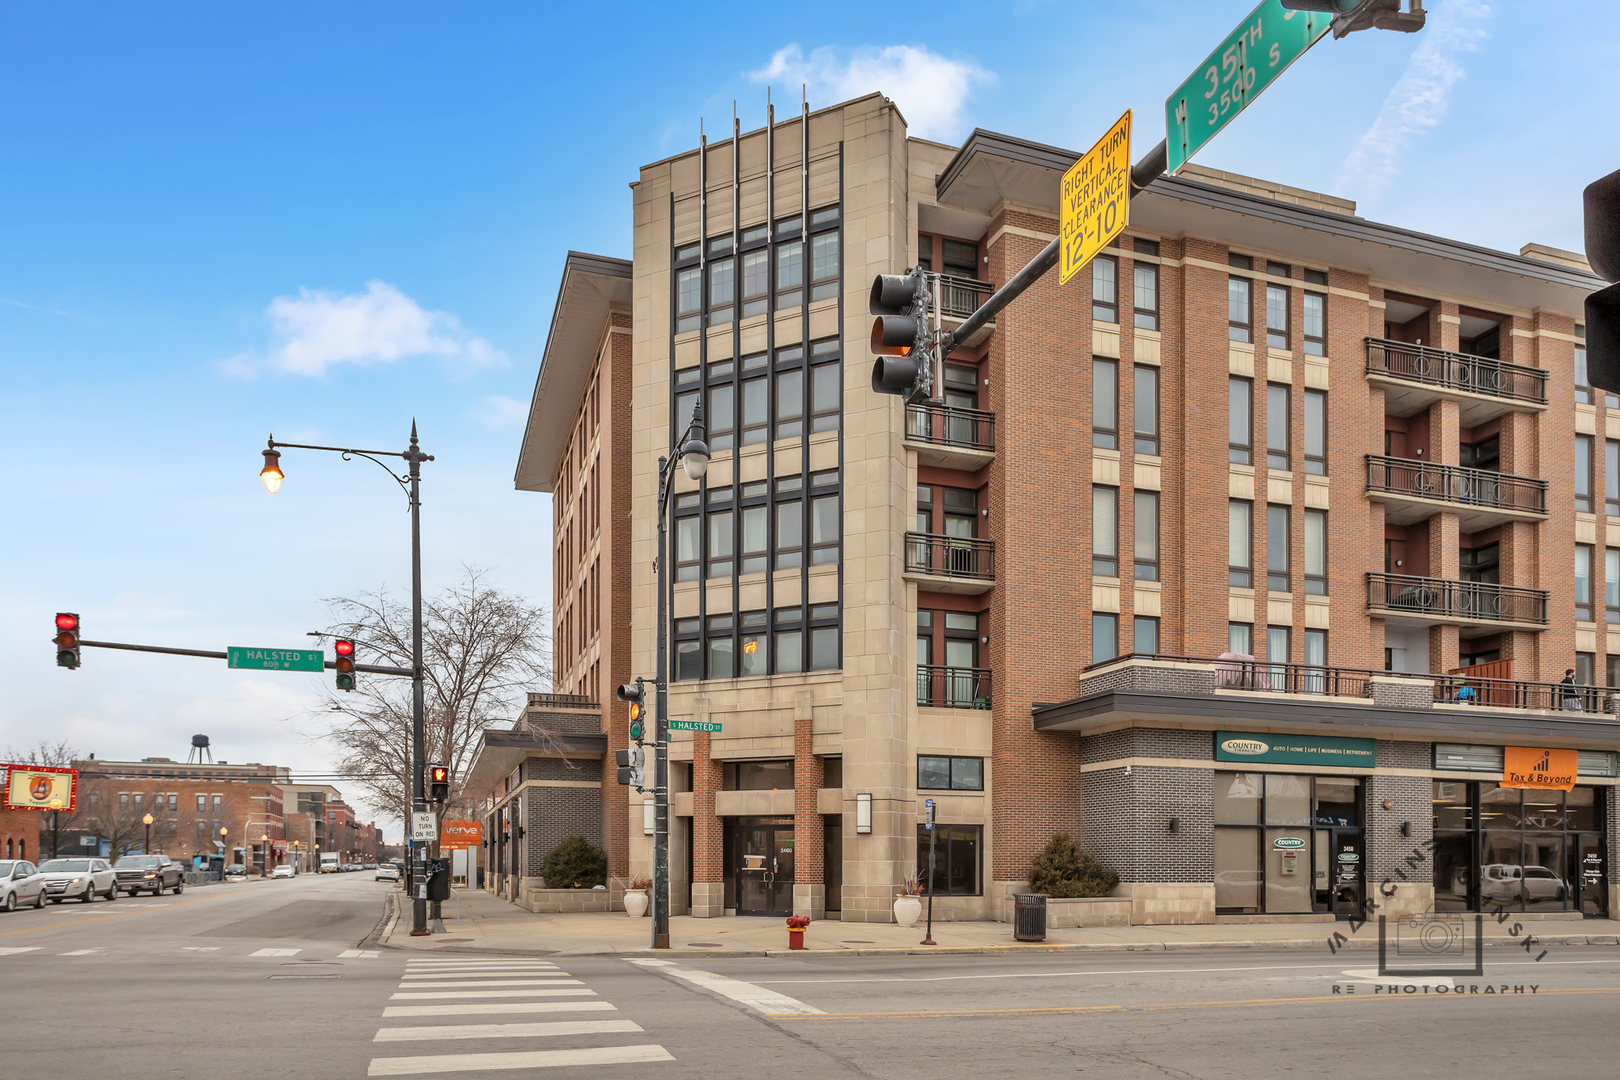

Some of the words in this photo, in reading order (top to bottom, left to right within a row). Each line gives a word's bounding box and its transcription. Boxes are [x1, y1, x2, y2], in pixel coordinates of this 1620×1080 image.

[1204, 18, 1263, 99] 35TH
[1208, 67, 1256, 125] 3500
[1269, 42, 1281, 68] S
[1064, 156, 1095, 200] RIGHT
[1100, 123, 1127, 164] TURN
[1070, 156, 1118, 213] VERTICAL
[1064, 169, 1124, 240] CLEARANCE
[1065, 191, 1123, 272] 12'-10"
[246, 650, 301, 661] HALSTED
[678, 722, 714, 731] HALSTED
[1227, 741, 1263, 750] COUNTRY
[1510, 773, 1525, 782] Tax
[1528, 774, 1534, 782] &
[1537, 774, 1572, 784] Beyond
[445, 826, 478, 835] verve
